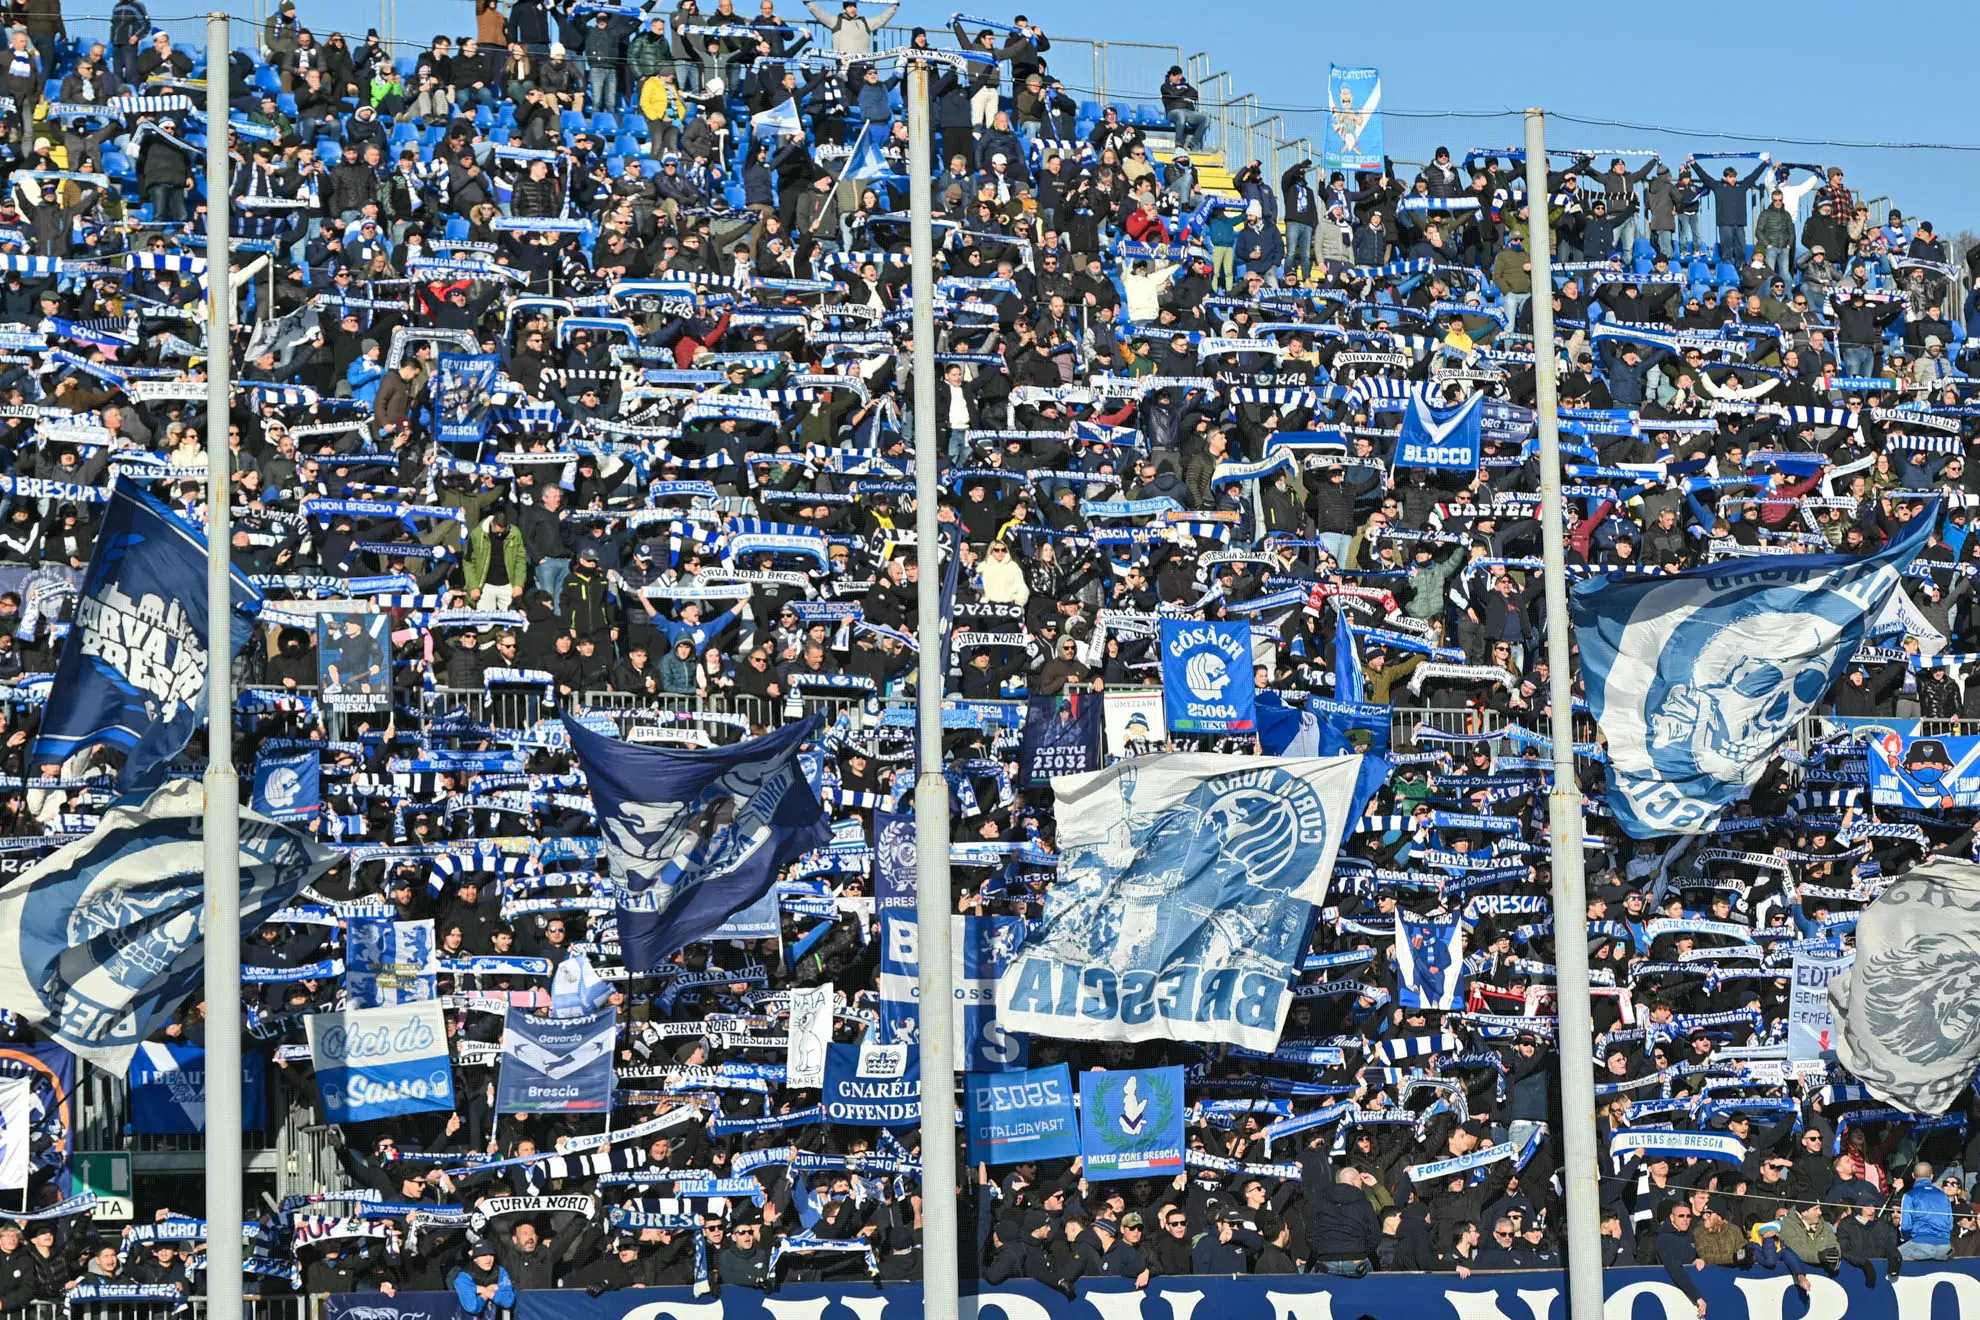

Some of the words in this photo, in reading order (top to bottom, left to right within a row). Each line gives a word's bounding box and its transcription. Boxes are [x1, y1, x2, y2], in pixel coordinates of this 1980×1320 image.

[1217, 196, 1249, 206] BRESCIA
[441, 358, 495, 372] GENTLEMEN
[1339, 353, 1373, 365] CURVA
[1375, 353, 1404, 364] NORD
[0, 405, 37, 415] NORD
[441, 424, 480, 437] BRESCIA
[1403, 444, 1472, 466] BLOCCO
[17, 477, 96, 501] BRESCIA
[309, 501, 343, 513] UNION
[346, 502, 393, 514] BRESCIA
[1448, 502, 1534, 517] CASTEL
[1091, 527, 1129, 542] BRESCIA
[1131, 527, 1168, 540] CALCIO
[1202, 551, 1237, 566] BRESCIA
[1238, 551, 1266, 562] SIAMO
[697, 567, 731, 584] CURVA
[732, 569, 765, 580] NORD
[825, 602, 863, 614] BRESCIA
[953, 603, 1022, 617] OVATO
[992, 633, 1024, 645] NORD
[1169, 624, 1246, 662] GÖSÀCH
[322, 692, 368, 705] UBRIACHI
[369, 694, 388, 705] DEL
[1108, 699, 1158, 709] LUMEZZANE
[333, 703, 376, 714] BRESCIA
[968, 704, 1003, 714] BRESCIA
[1187, 702, 1238, 719] 25064
[635, 727, 699, 740] BRESCIA
[848, 728, 909, 740] C.U.C.S.
[1055, 744, 1087, 756] STYLE
[430, 759, 484, 771] BRESCIA
[1032, 755, 1087, 769] 25032
[751, 772, 789, 821] NORD
[1697, 850, 1729, 866] CURVA
[1730, 851, 1764, 864] NORD
[1706, 877, 1734, 889] SIAMO
[885, 897, 920, 907] BRES
[1476, 895, 1548, 915] BRESCIA
[737, 922, 777, 933] BRESCIA
[245, 967, 275, 977] UNION
[676, 970, 723, 984] CURVA
[1316, 980, 1365, 995] NORD
[1795, 990, 1829, 1006] SEMP
[1682, 1020, 1693, 1030] SI
[1694, 1012, 1754, 1029] PASSEGGIA
[1792, 1010, 1834, 1025] SEMPE
[663, 1022, 705, 1035] CURVA
[705, 1020, 738, 1033] NORD
[320, 1025, 391, 1062] Chei
[393, 1014, 435, 1053] de
[537, 1032, 584, 1046] Gavardo
[730, 1034, 771, 1046] BRESCIA
[343, 1073, 430, 1108] Sasso
[527, 1084, 580, 1098] Brescia
[1354, 1110, 1384, 1122] NORD
[1628, 1134, 1665, 1146] ULTRAS
[1683, 1135, 1724, 1149] BRESCIA
[1088, 1153, 1116, 1166] MIXED
[1117, 1151, 1142, 1163] ZONE
[1143, 1148, 1181, 1162] BRESCIA
[1417, 1161, 1454, 1178] FORZA
[716, 1177, 754, 1192] BRESCIA
[490, 1196, 542, 1213] CURVA
[545, 1195, 590, 1211] NORD
[157, 1222, 198, 1239] NORD
[99, 1283, 137, 1297] NORD
